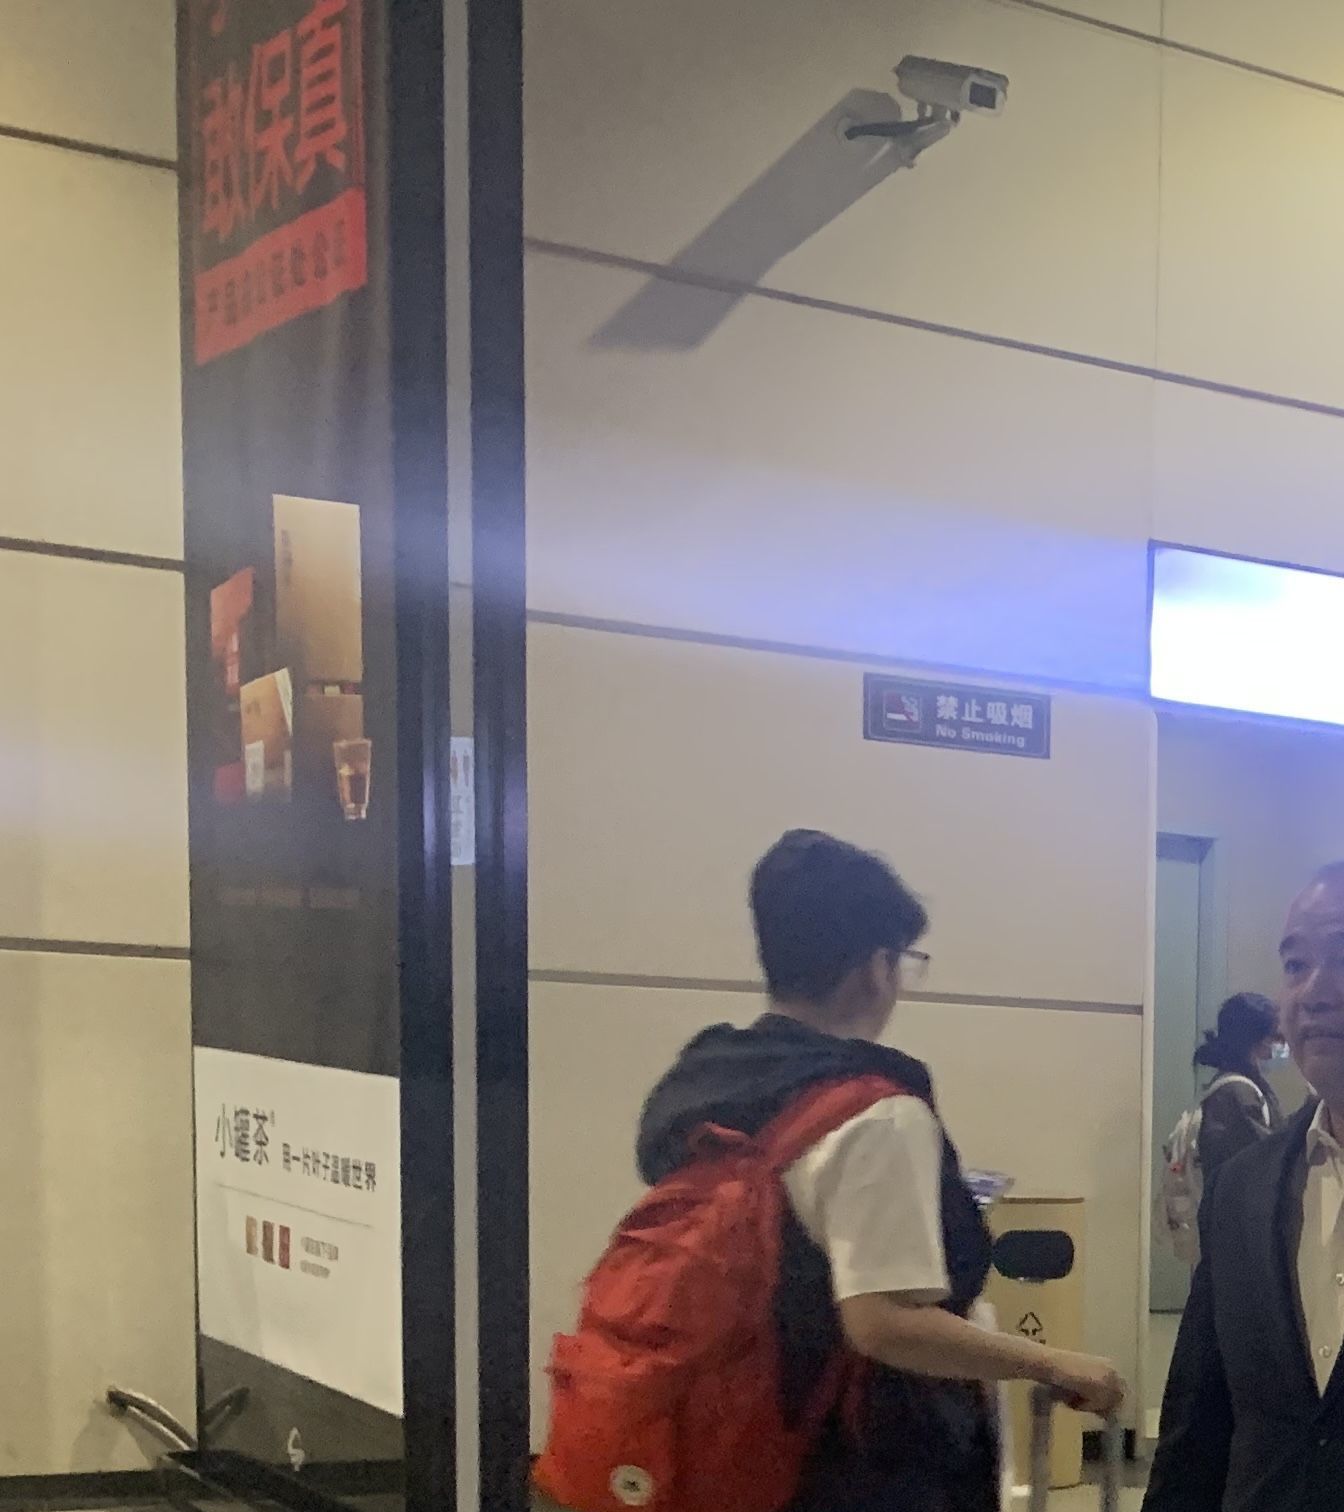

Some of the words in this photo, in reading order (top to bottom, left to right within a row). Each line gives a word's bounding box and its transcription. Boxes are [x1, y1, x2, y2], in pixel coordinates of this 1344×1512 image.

[936, 694, 1034, 729] 禁止吸烟
[936, 724, 957, 739] No
[961, 727, 1025, 748] Smoking
